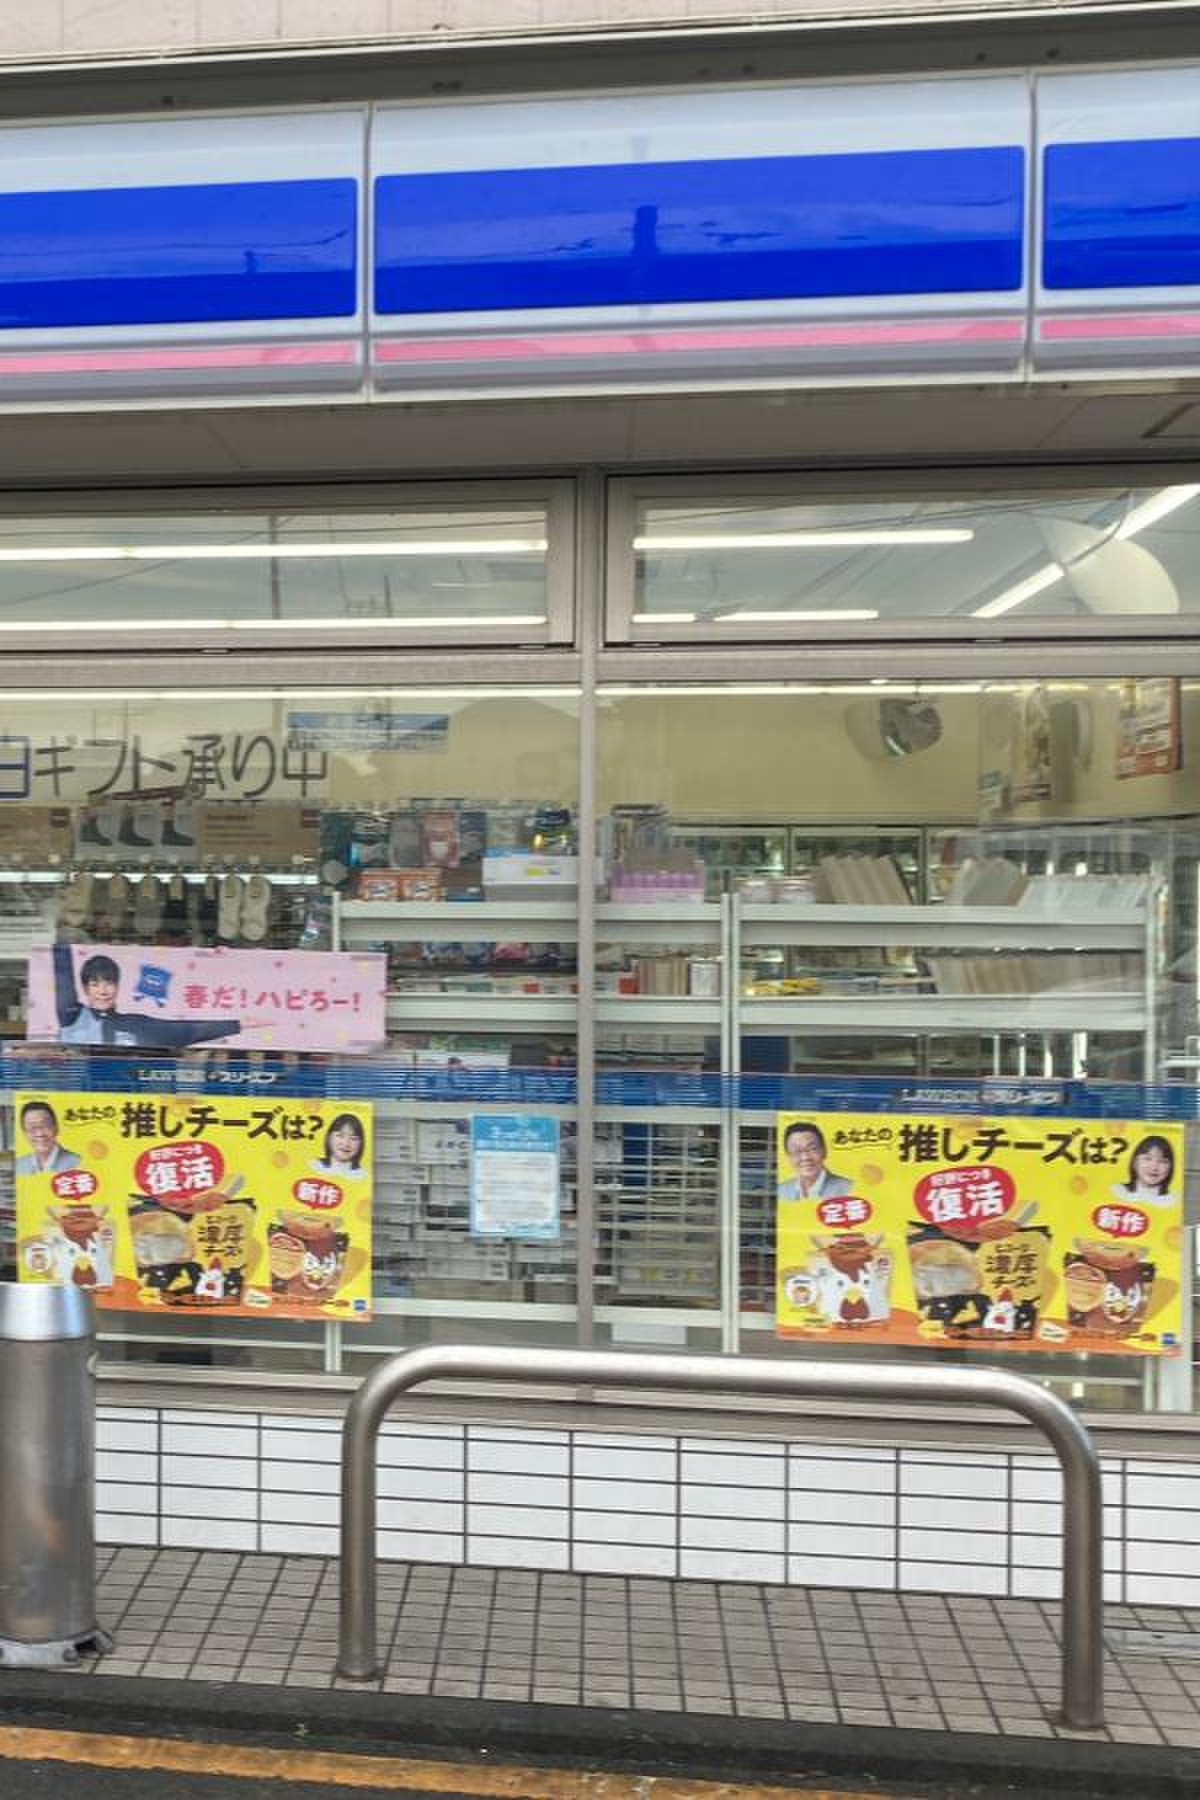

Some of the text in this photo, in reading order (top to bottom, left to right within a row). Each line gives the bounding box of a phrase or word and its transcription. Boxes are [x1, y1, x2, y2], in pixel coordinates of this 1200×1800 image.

[898, 1122, 1130, 1165] 推しチーズは?
[145, 1156, 215, 1196] 復活
[297, 1181, 340, 1205] 新作
[926, 1180, 1005, 1222] 復活
[1098, 1207, 1146, 1231] 新作
